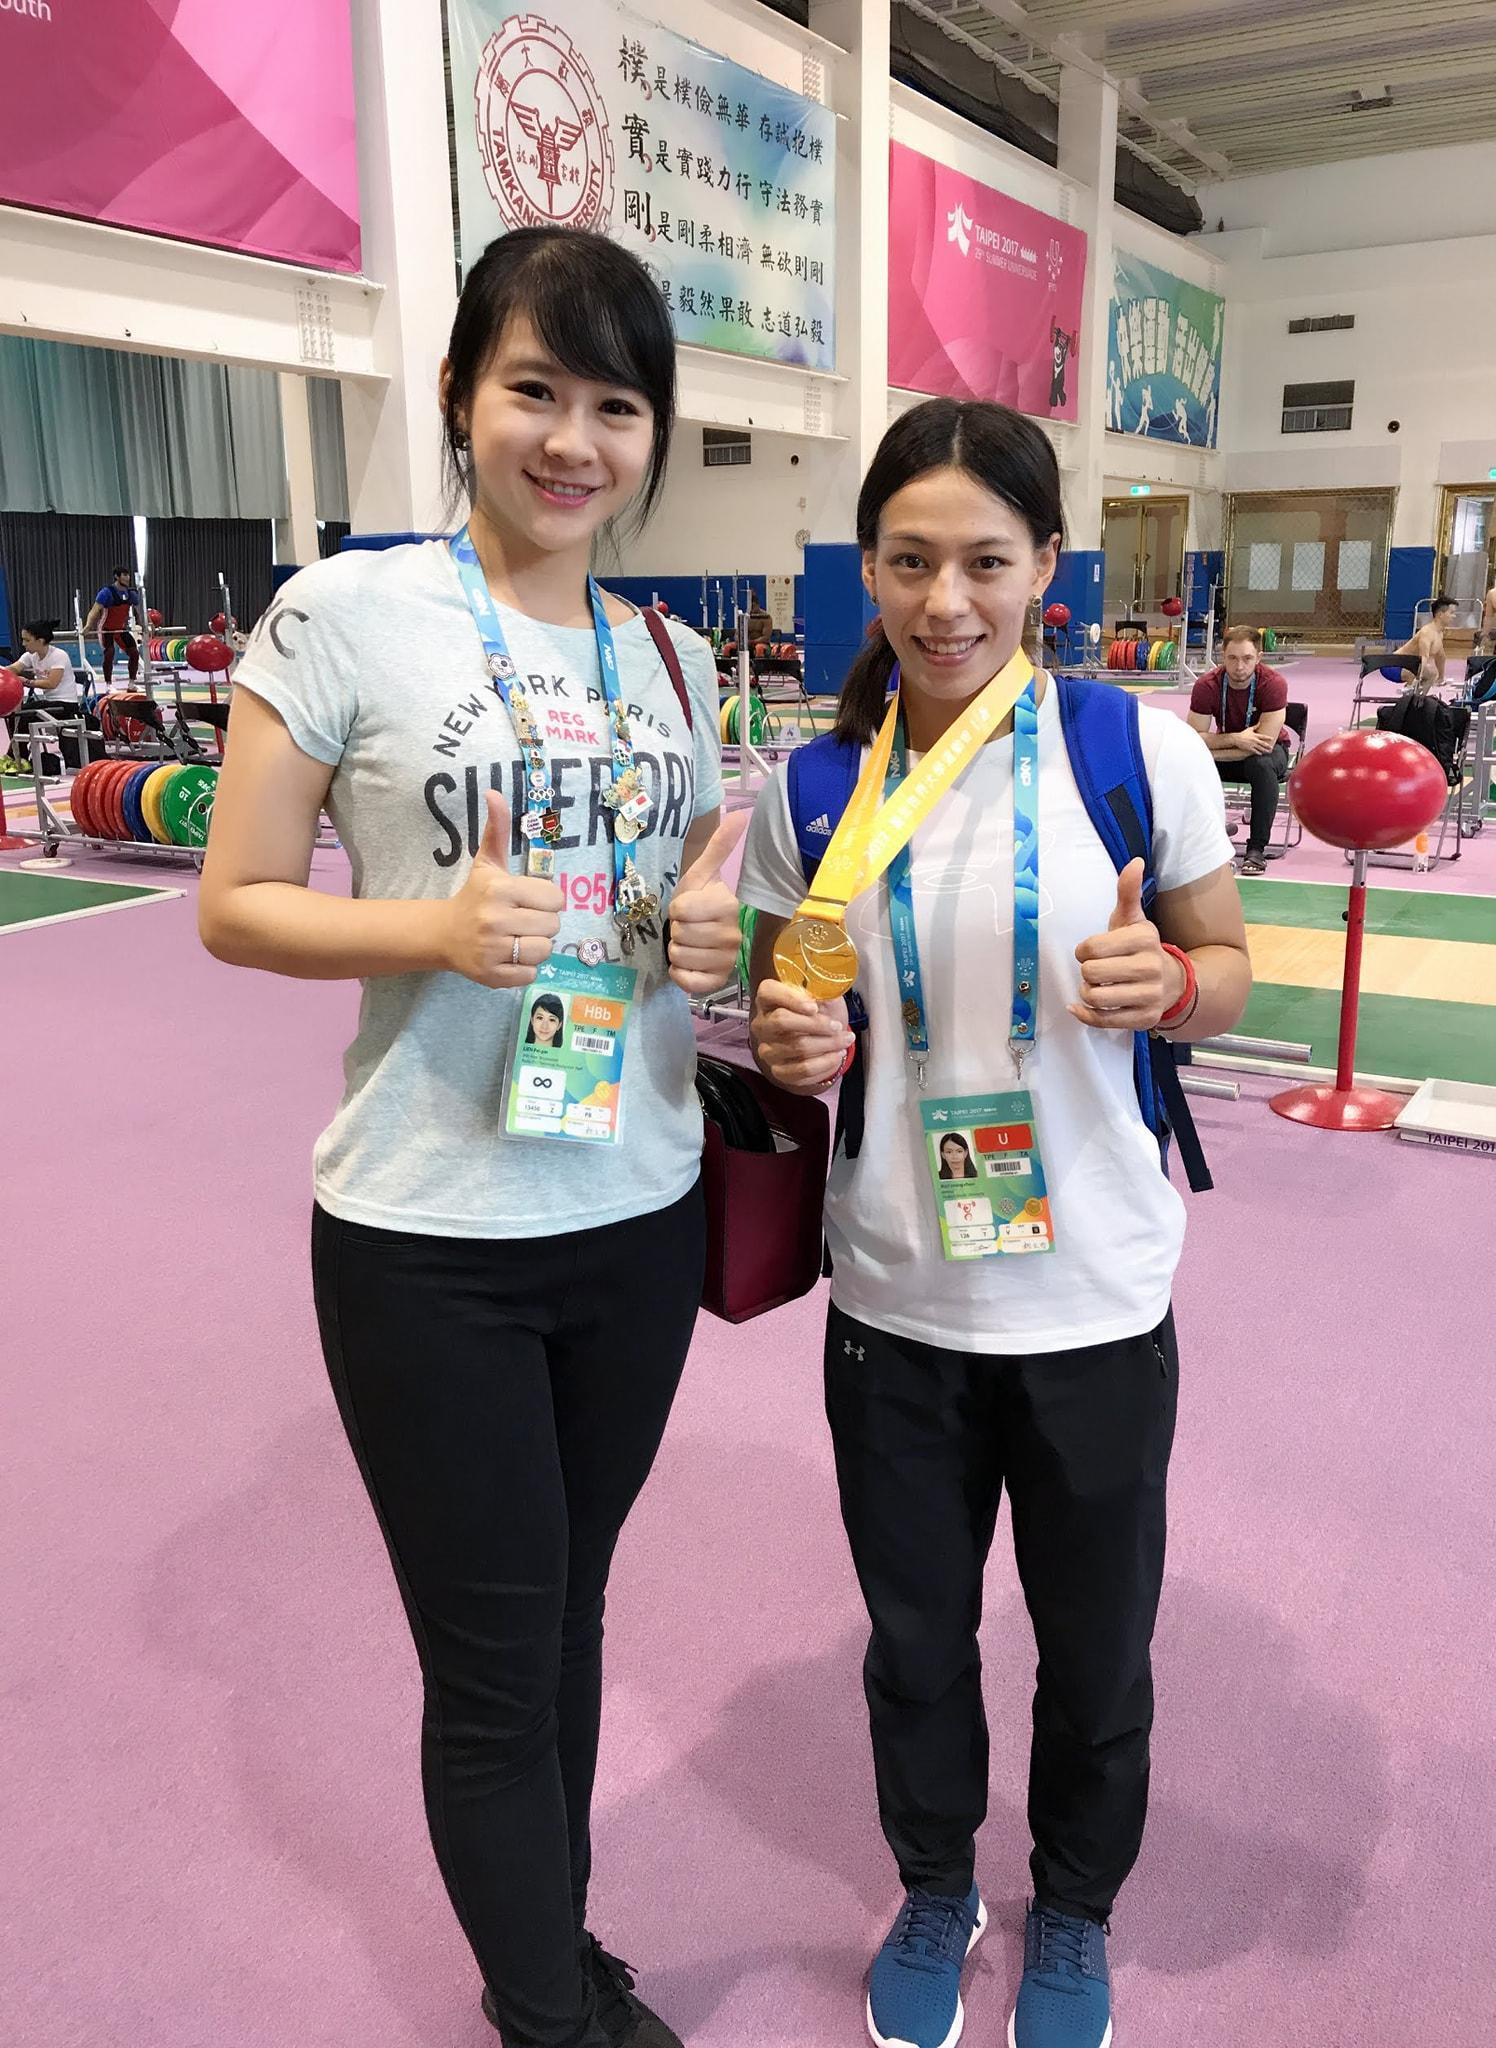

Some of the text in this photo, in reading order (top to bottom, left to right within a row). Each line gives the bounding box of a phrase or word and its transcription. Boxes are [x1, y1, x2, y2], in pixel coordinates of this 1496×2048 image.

[975, 224, 1000, 250] TAIPEI
[1001, 236, 1019, 257] 2017
[432, 674, 671, 758] NEW YRK PRIS
[548, 709, 585, 726] REG
[545, 725, 600, 745] MARK
[805, 825, 832, 836] adidas
[584, 1004, 611, 1021] HBb
[998, 1132, 1008, 1145] U
[1425, 1132, 1468, 1148] TAIPEI
